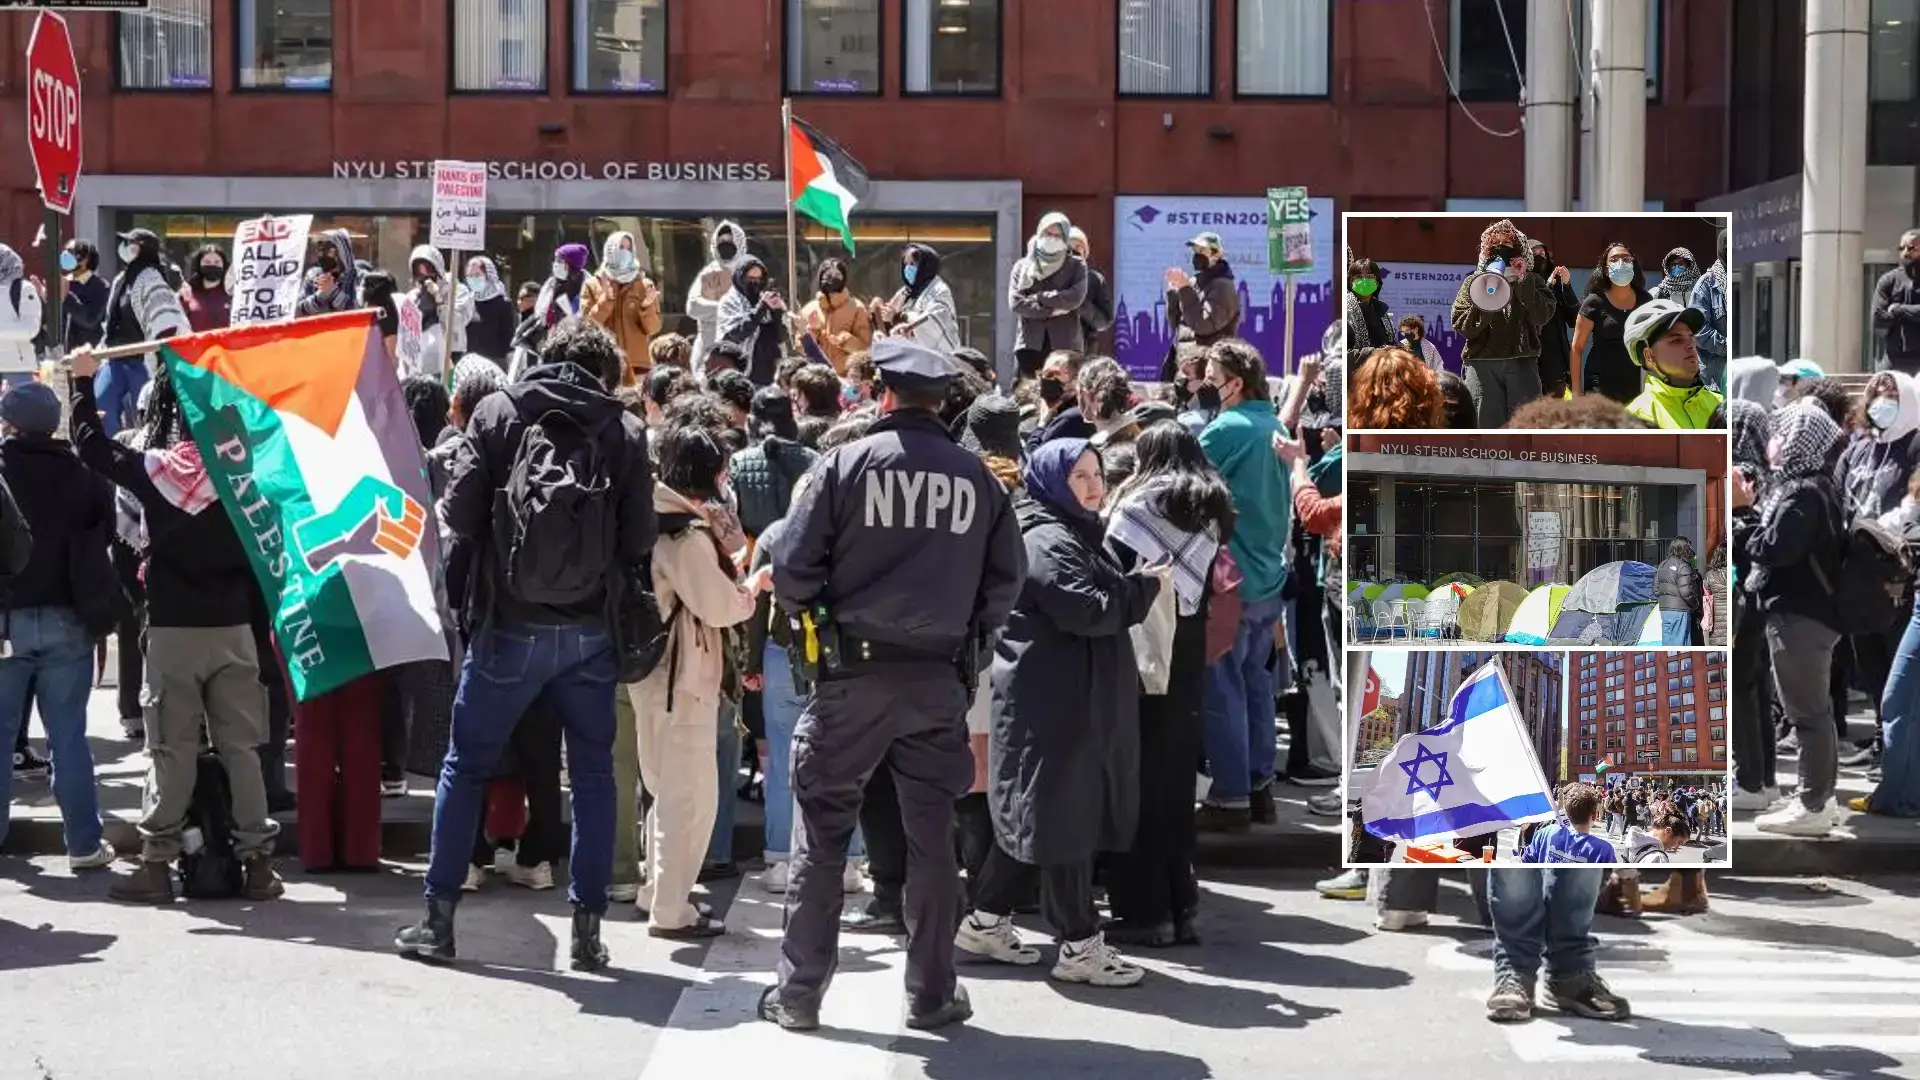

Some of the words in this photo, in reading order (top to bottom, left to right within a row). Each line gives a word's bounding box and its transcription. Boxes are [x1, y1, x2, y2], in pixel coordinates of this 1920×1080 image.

[34, 68, 77, 151] STOP
[333, 161, 386, 179] NYU
[395, 161, 434, 179] STE
[488, 161, 592, 180] SCHOOL
[603, 162, 642, 180] OF
[647, 162, 771, 181] BUSINESS
[1167, 211, 1268, 226] #STERN202
[1269, 199, 1310, 221] YES
[244, 219, 292, 241] END
[242, 244, 283, 264] ALL
[262, 261, 299, 279] AID
[1394, 272, 1462, 281] #STERN2024
[242, 287, 274, 306] TO
[1431, 298, 1452, 306] HALL
[1380, 443, 1409, 455] NYU
[1414, 445, 1457, 457] STERN
[1462, 448, 1515, 461] SCHOOL
[1520, 450, 1537, 461] OF
[1541, 452, 1599, 465] BUSINESS
[865, 469, 976, 534] NYPD
[215, 434, 326, 676] PALESTINE
